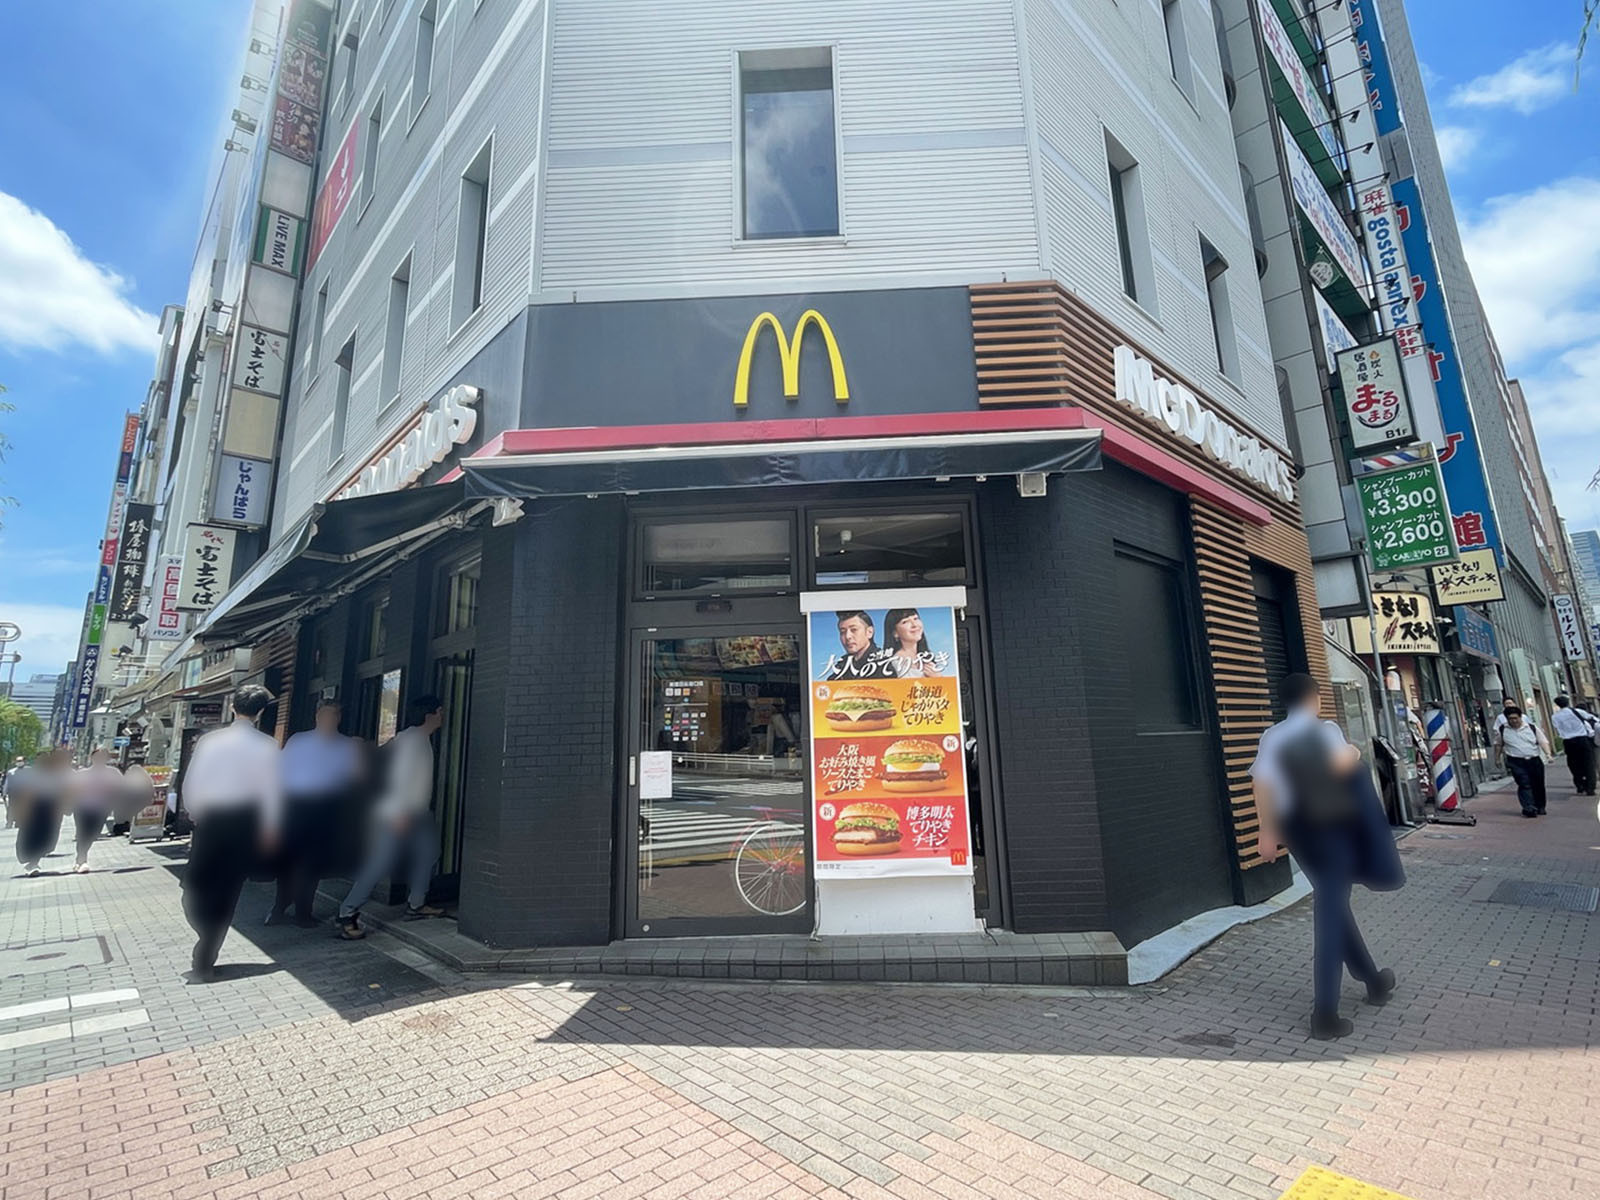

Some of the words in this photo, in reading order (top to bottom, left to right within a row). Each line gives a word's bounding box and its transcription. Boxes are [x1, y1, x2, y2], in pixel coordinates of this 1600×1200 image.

[1113, 345, 1294, 502] McDonald's
[192, 545, 221, 605] 富士そば
[1438, 561, 1480, 576] いきなり
[819, 651, 952, 679] 大人のてりやき
[907, 685, 943, 699] 北海道
[904, 712, 945, 725] てりやき
[837, 744, 859, 756] 大阪
[827, 780, 866, 791] てりやき
[906, 806, 955, 820] 博多明太
[909, 819, 952, 833] てりやき
[912, 832, 948, 847] チキン
